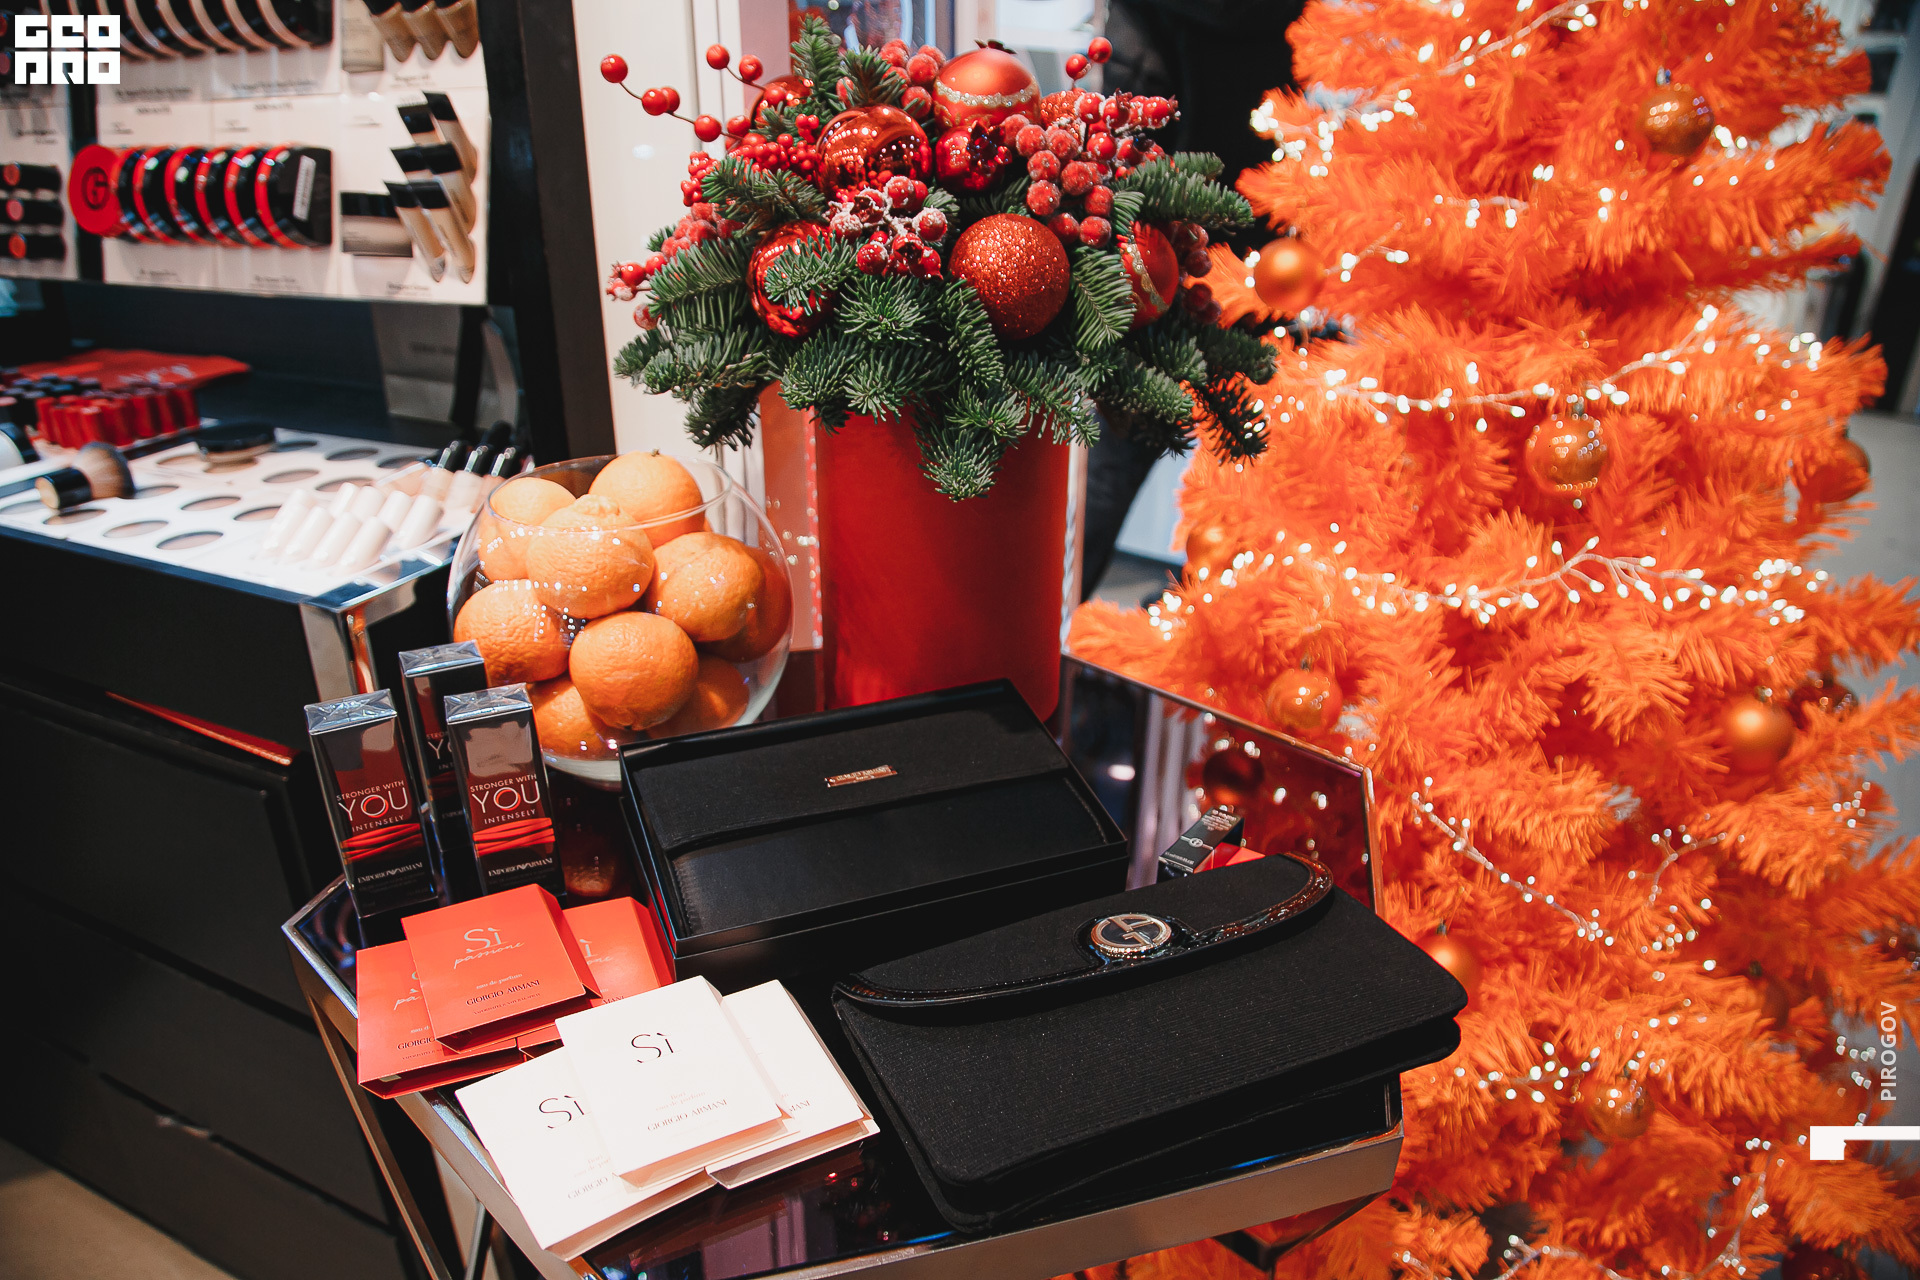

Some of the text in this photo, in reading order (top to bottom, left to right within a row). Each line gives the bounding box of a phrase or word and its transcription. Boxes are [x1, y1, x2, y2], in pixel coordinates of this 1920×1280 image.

[336, 780, 405, 801] STRONGER WITH
[470, 774, 537, 793] STRONGER WITH
[338, 787, 408, 821] YOU
[472, 781, 541, 814] YOU
[352, 815, 405, 833] INTENSELY
[484, 809, 536, 825] INTENSELY
[453, 942, 525, 970] passione
[466, 990, 504, 1006] GIORGIO
[507, 980, 540, 994] ARMANI
[631, 1032, 675, 1063] Sì
[539, 1095, 586, 1129] Sì
[647, 1113, 688, 1131] GIORGIO
[691, 1098, 728, 1117] ARMANI
[567, 1176, 609, 1199] GIORGIO
